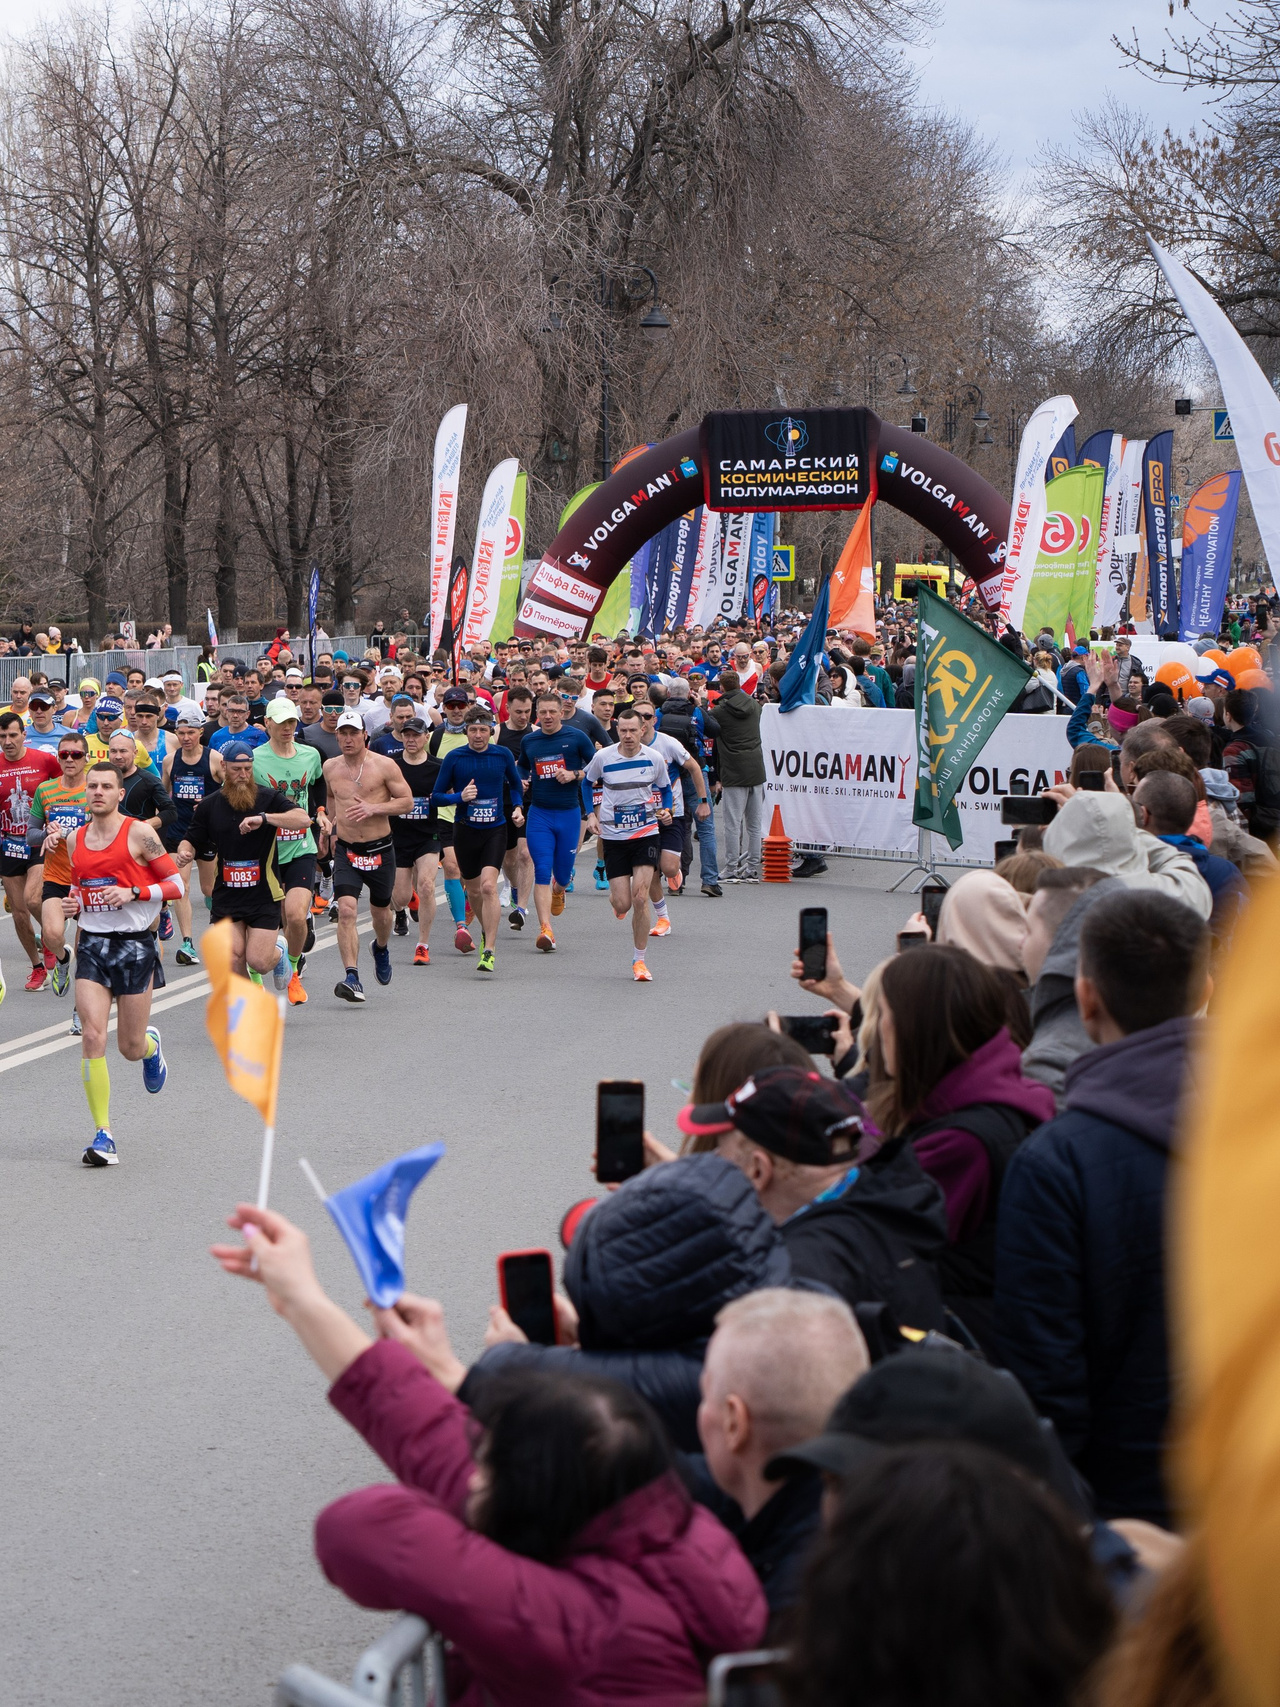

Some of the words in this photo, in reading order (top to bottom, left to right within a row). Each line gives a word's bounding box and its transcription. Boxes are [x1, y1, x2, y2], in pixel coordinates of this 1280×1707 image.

[720, 454, 859, 471] САМАРСКИЙ
[721, 468, 859, 484] КОСМИЧЕСКИЙ
[1152, 464, 1162, 503] PRO
[721, 484, 858, 497] ПОЛУМАРАФОН
[901, 463, 989, 539] VOLGAMAN
[584, 474, 672, 551] VOLGAMAN
[1204, 516, 1220, 579] INNOVATION
[536, 566, 568, 591] Альфа
[570, 583, 596, 603] Банк
[1198, 584, 1213, 627] HEALTHY
[534, 611, 583, 633] Пятёрочка
[542, 763, 559, 774] 1516
[771, 750, 895, 783] VOLGAMAN
[179, 785, 199, 794] 2095
[853, 788, 895, 798] TRIATHLON
[56, 815, 77, 827] 2299
[473, 808, 493, 818] 2333
[622, 814, 639, 824] 2141
[354, 856, 374, 866] 1854
[230, 871, 252, 881] 1083
